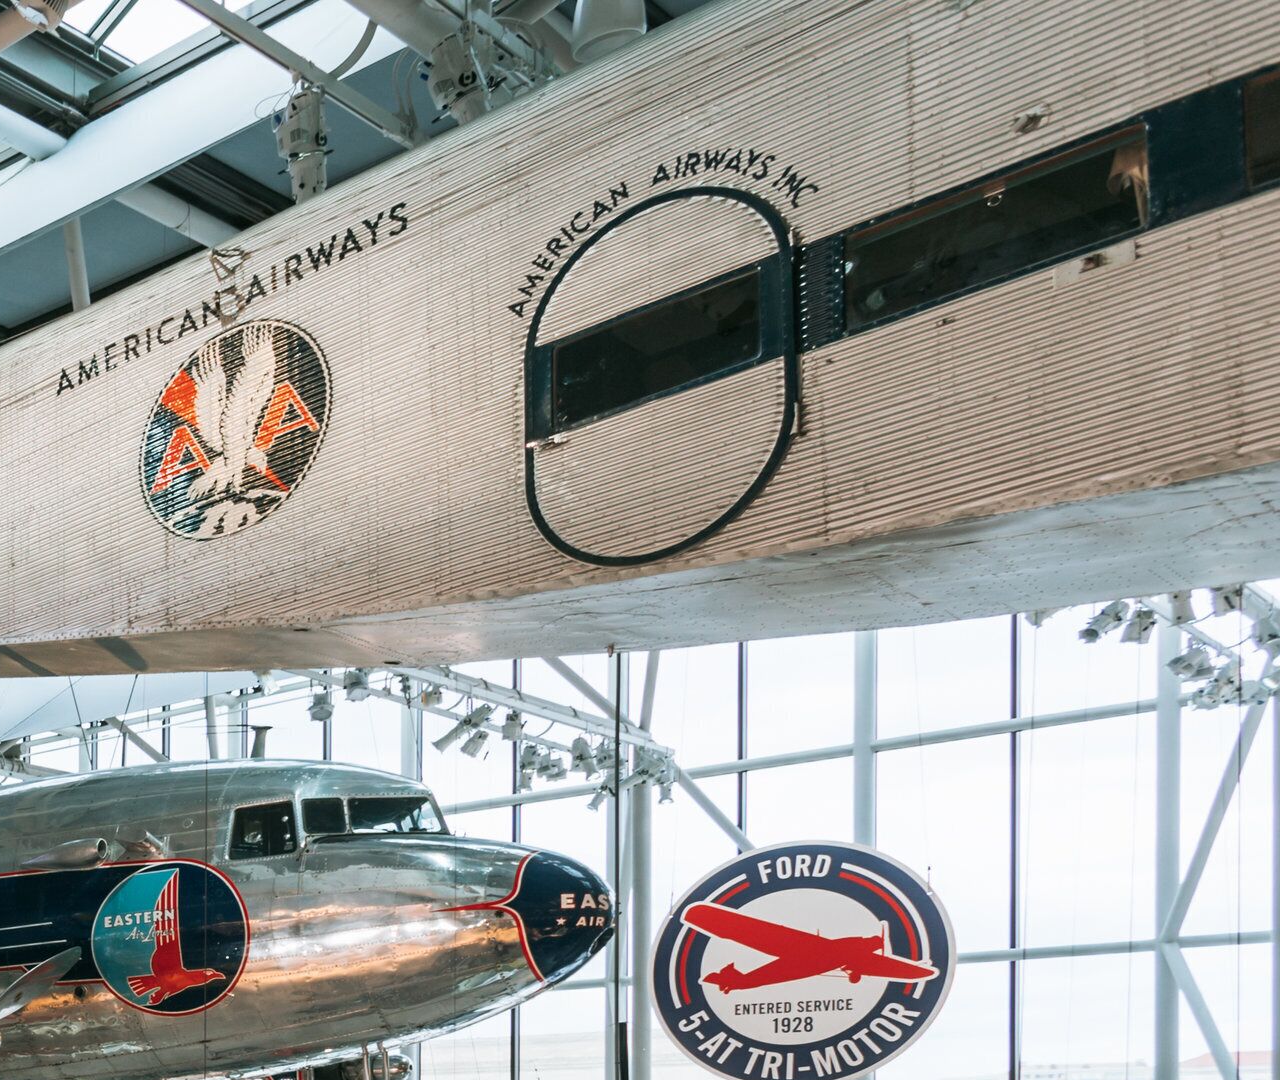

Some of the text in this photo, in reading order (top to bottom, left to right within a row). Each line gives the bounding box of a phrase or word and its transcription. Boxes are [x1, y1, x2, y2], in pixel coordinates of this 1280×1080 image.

[507, 149, 819, 318] AMERICAN AIRWAYS INC
[56, 202, 409, 396] AMERICAN AIRWAYS
[757, 854, 832, 884] FORD
[104, 909, 175, 928] EASTERN
[575, 916, 606, 927] AIR
[734, 998, 854, 1016] ENTERED SERVICE
[771, 1016, 815, 1034] 1928
[678, 1001, 922, 1080] 5-AT TRI-MOTOR
